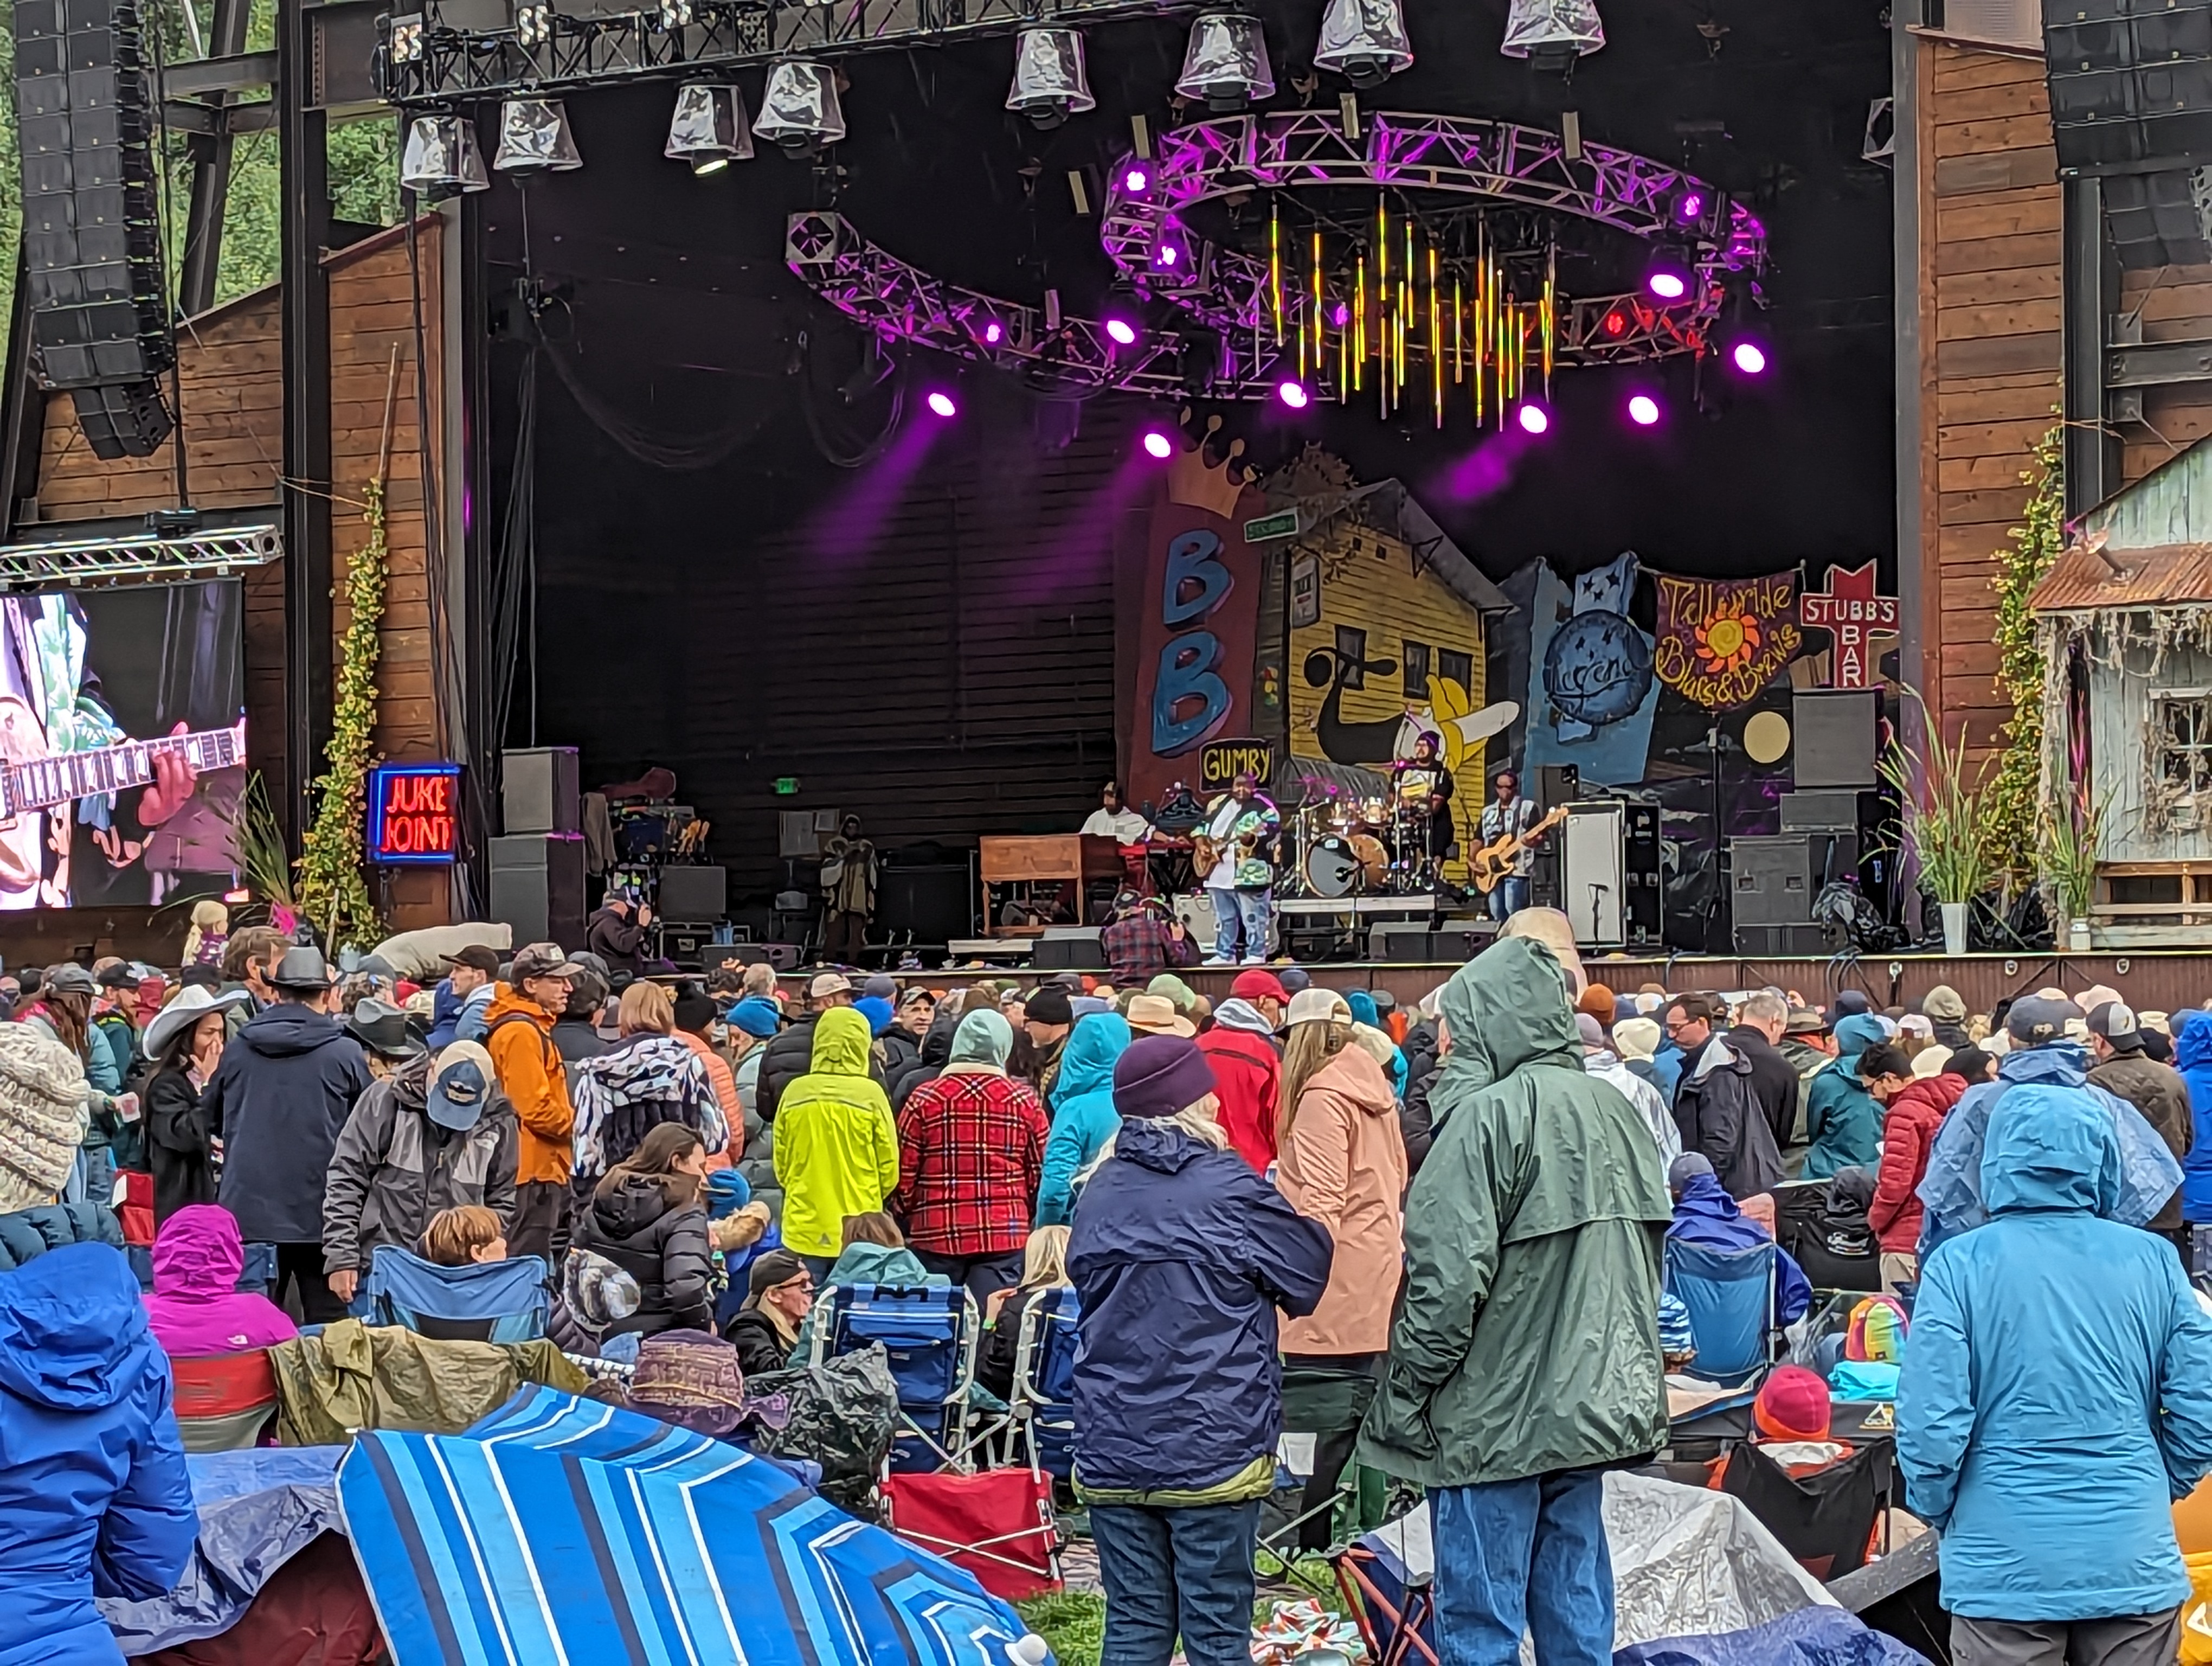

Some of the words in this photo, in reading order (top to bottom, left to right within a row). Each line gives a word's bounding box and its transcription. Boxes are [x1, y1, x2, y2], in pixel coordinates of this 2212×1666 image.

[1660, 576, 1790, 628] Telluride
[1806, 599, 1895, 623] STUBB'S
[1842, 624, 1861, 687] BAR
[1204, 748, 1270, 784] GUMBY
[385, 777, 449, 813] JUKE
[380, 816, 454, 853] JOINT
